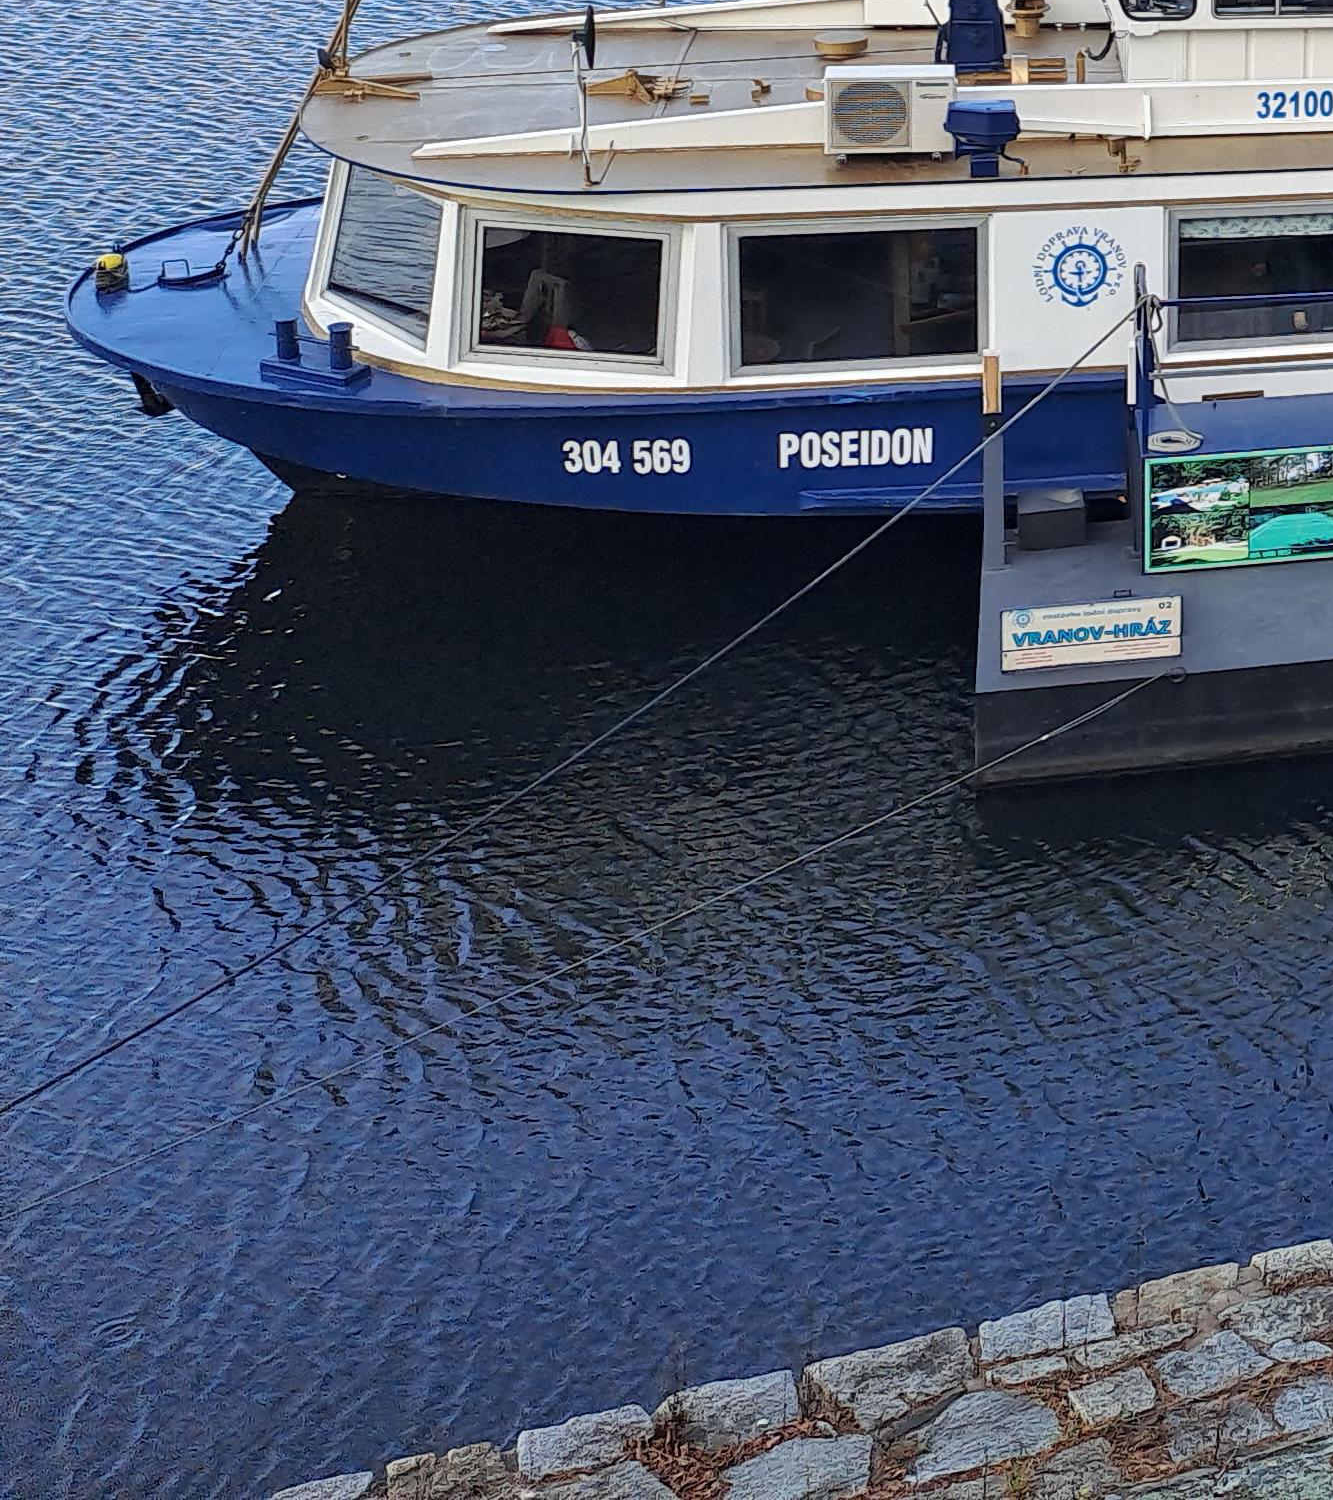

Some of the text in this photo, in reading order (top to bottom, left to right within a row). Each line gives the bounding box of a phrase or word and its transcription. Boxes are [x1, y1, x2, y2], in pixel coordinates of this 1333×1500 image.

[1037, 226, 1089, 261] DOPRAVA
[1093, 227, 1127, 269] VRANOV
[562, 438, 692, 474] 304 569
[778, 427, 934, 469] POSEIDON
[1158, 601, 1173, 610] 02
[1011, 616, 1173, 648] VRANOV-HRÁZ
